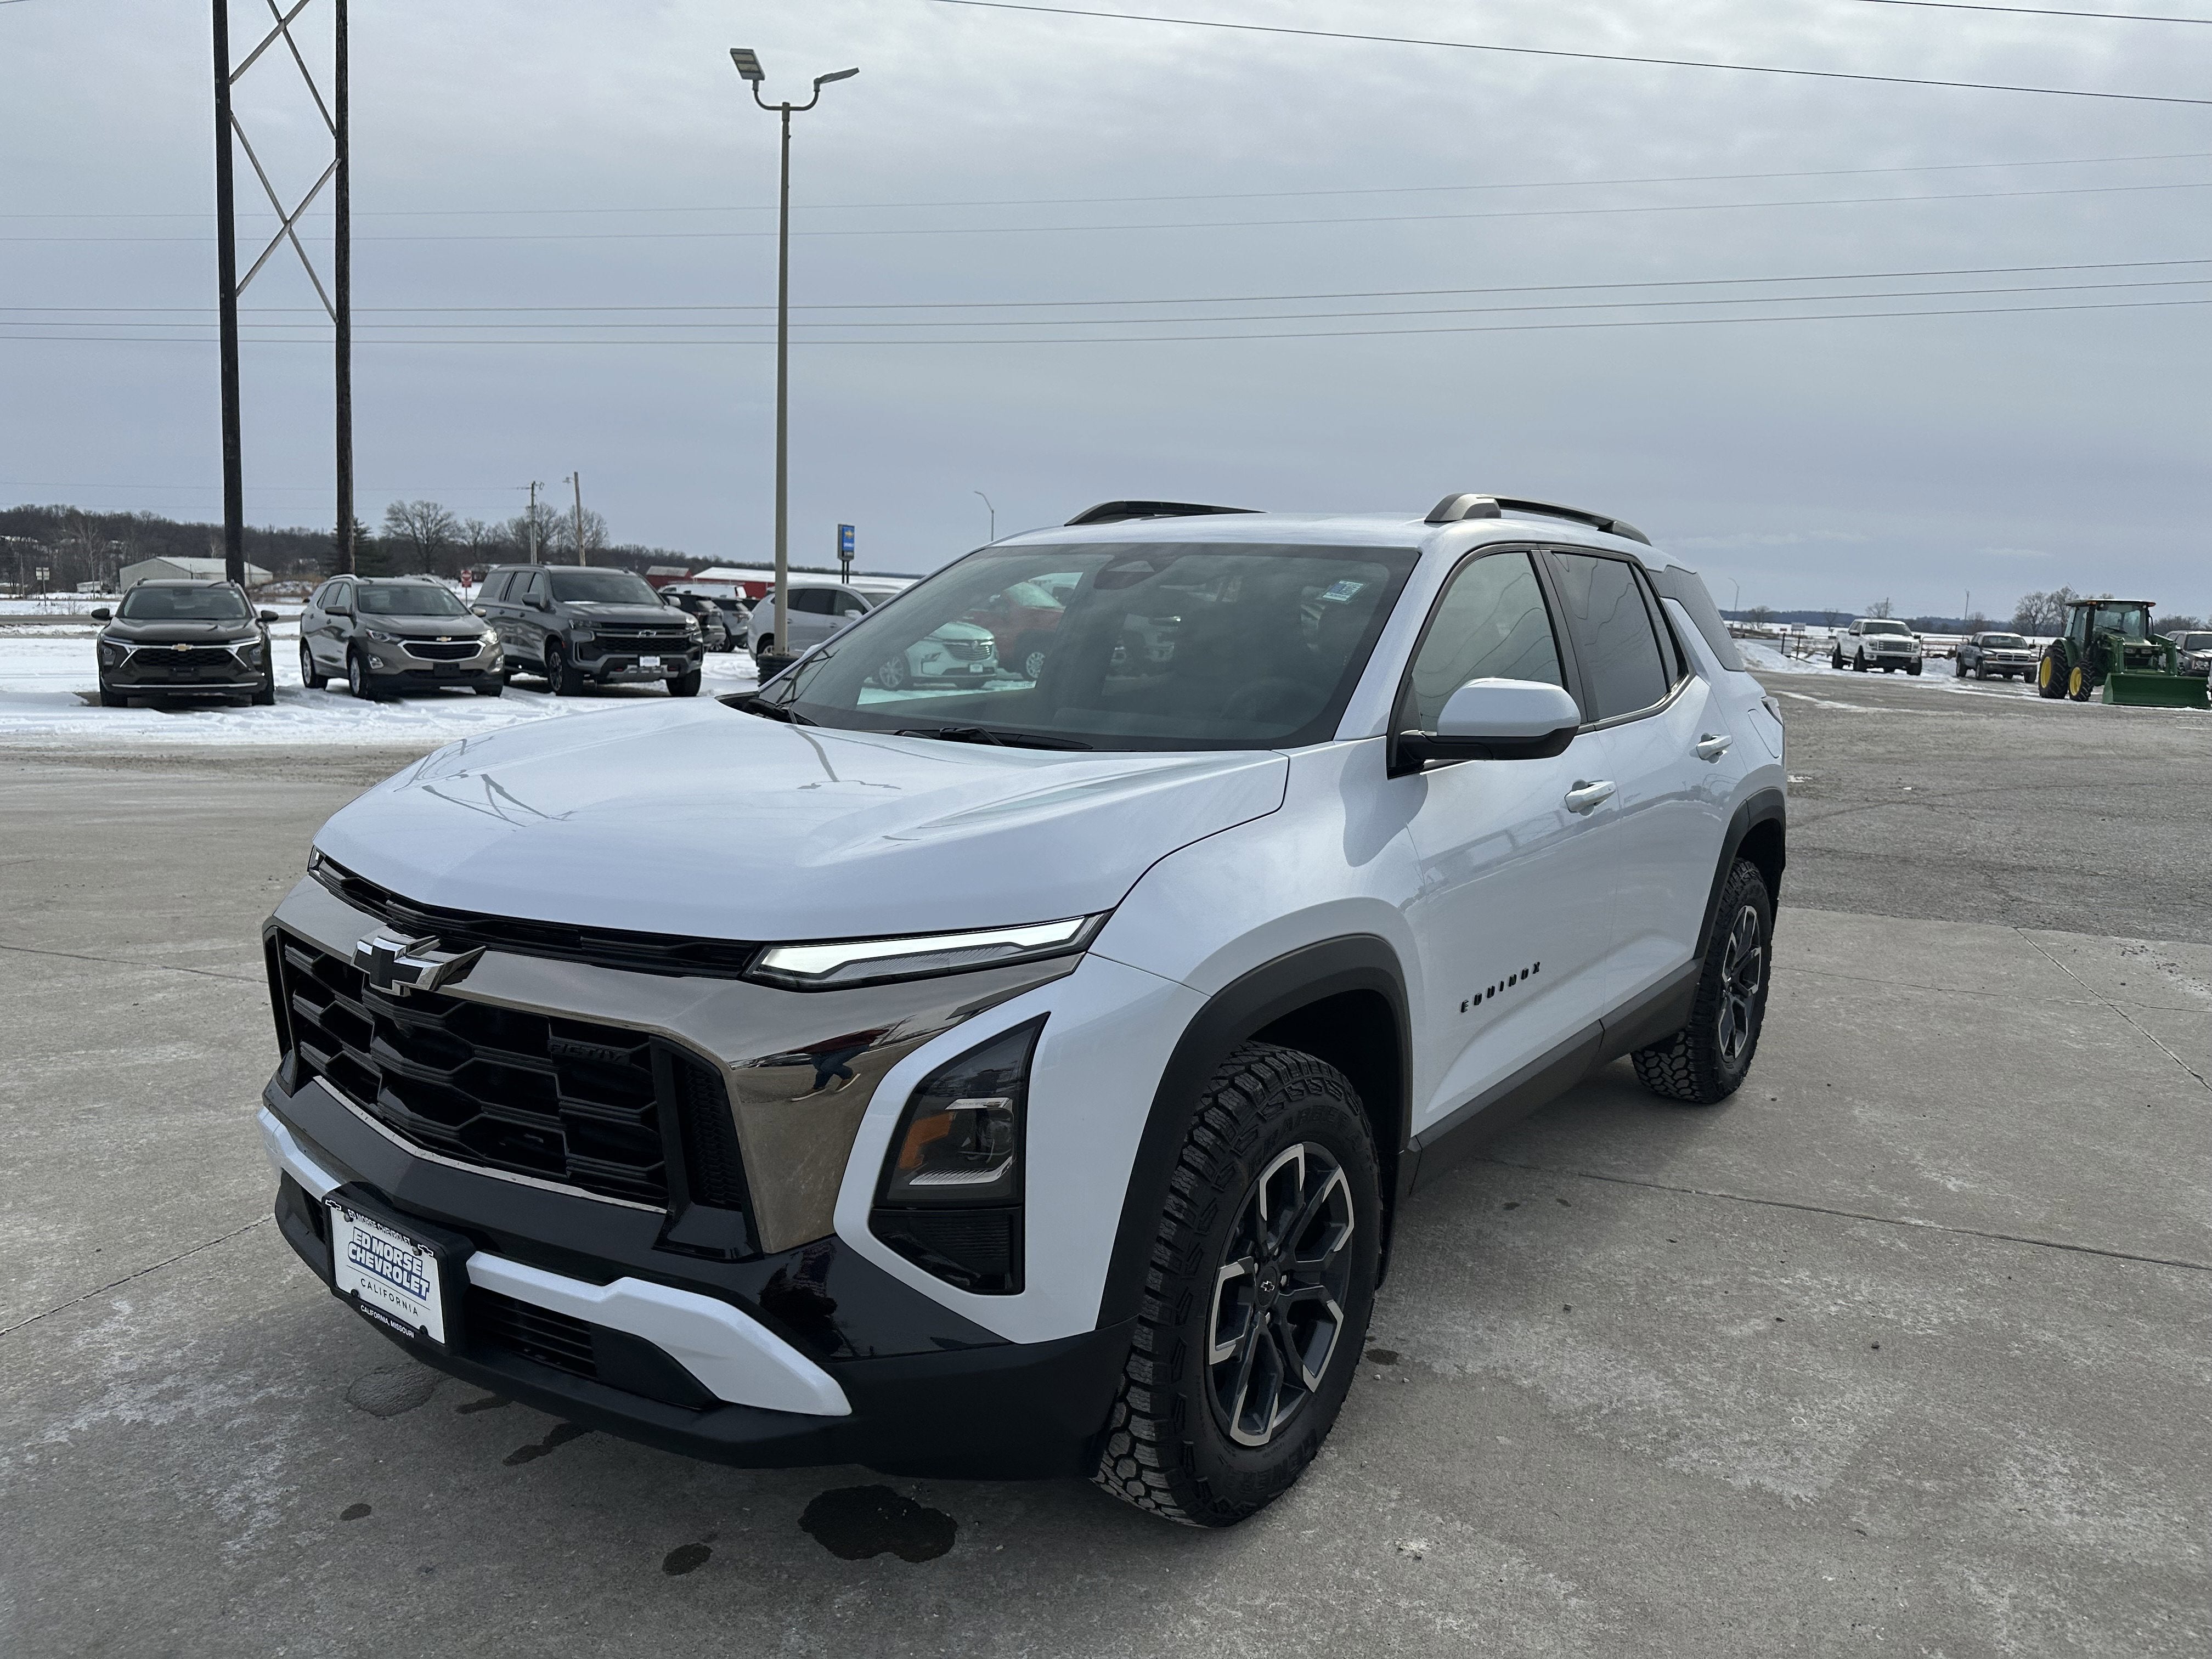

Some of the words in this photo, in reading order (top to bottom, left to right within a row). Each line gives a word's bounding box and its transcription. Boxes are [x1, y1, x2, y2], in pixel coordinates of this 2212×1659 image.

[1460, 961, 1541, 1013] EQUINOX
[348, 1242, 430, 1300] CHEVROLET
[354, 1227, 371, 1250] ED
[371, 1236, 422, 1278] MORSE
[360, 1278, 419, 1317] CALIFORNIA
[360, 1305, 390, 1327] CALIFORNIA,
[390, 1320, 414, 1339] MISSOURI
